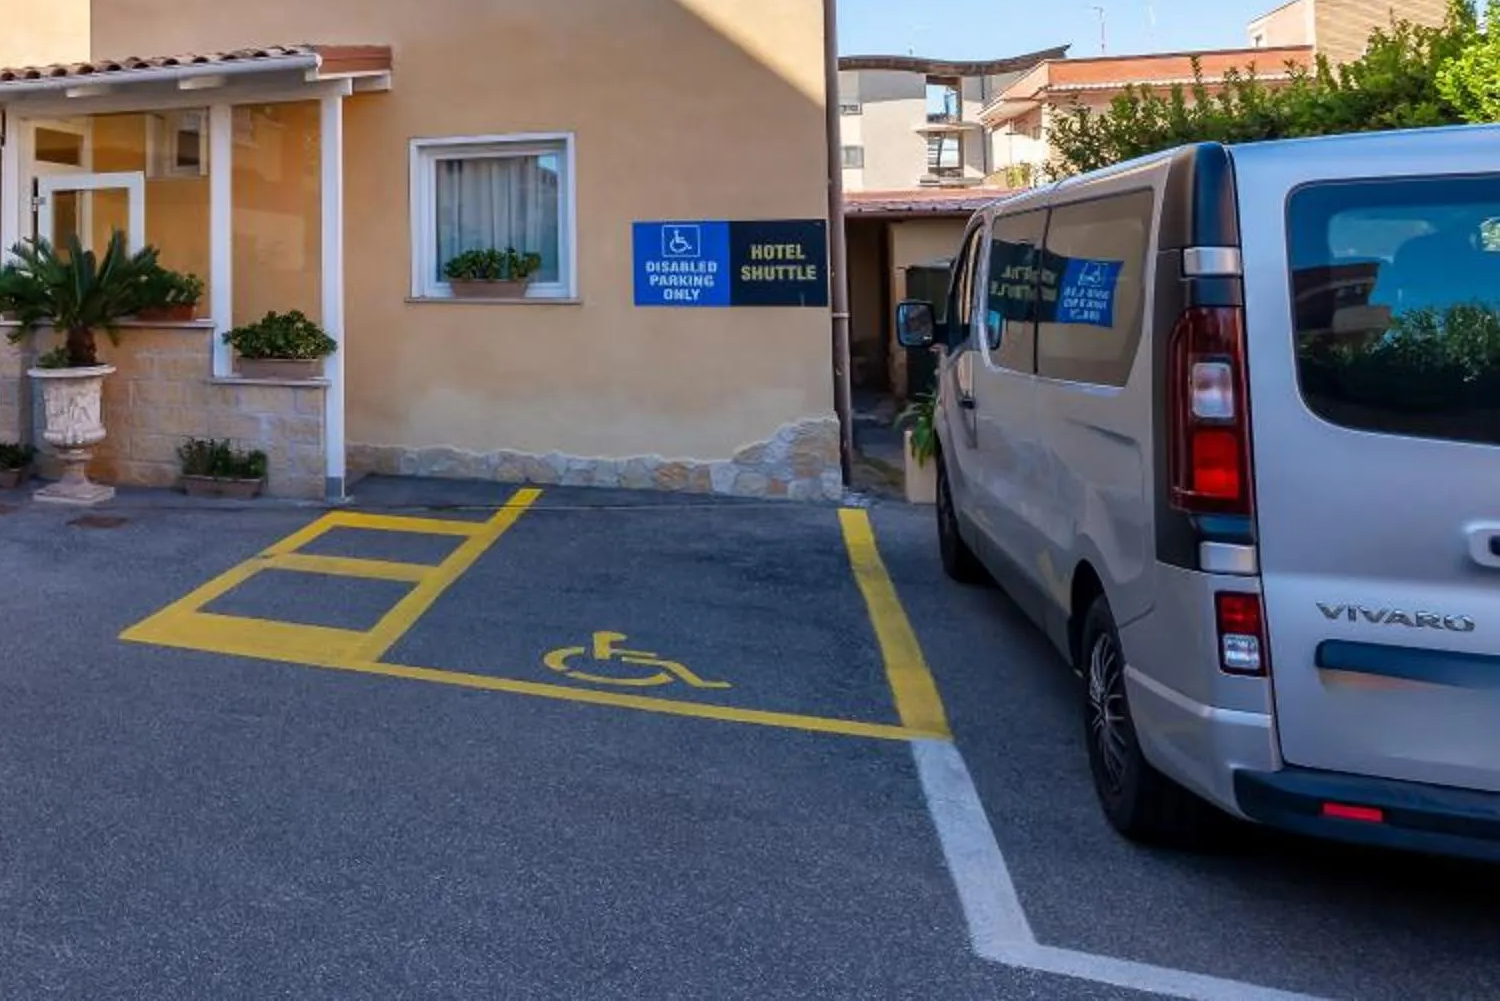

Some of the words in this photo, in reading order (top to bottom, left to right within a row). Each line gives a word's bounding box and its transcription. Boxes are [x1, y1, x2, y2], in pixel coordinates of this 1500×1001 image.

[751, 245, 805, 260] HOTEL
[646, 261, 718, 274] DISABLED
[741, 264, 817, 281] SHUTTLE
[650, 275, 715, 287] PARKING
[664, 288, 701, 301] ONLY
[1316, 601, 1476, 633] VIVARO
